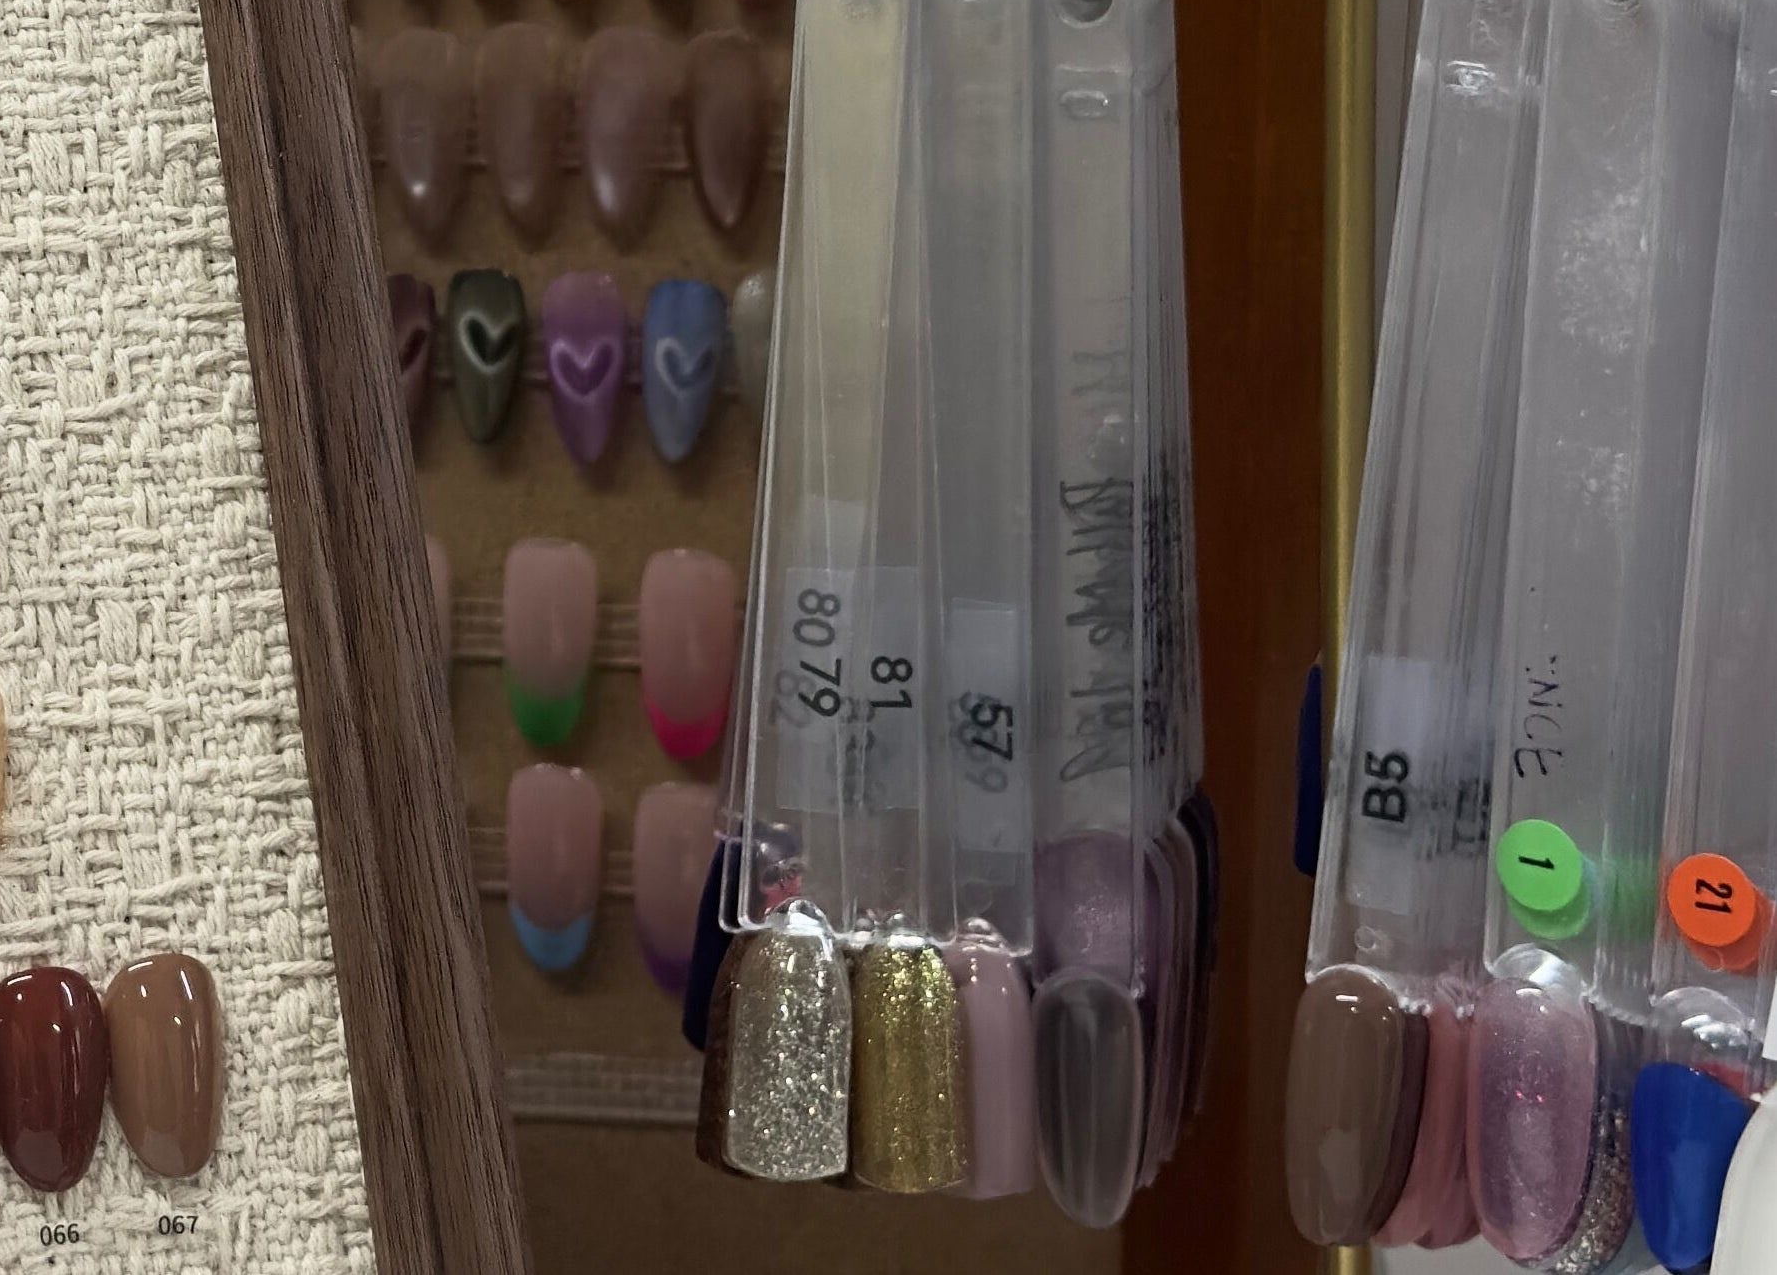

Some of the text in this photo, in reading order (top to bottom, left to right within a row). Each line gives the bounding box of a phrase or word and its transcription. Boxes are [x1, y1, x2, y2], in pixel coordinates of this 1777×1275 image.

[791, 587, 842, 648] 80
[797, 657, 843, 719] 79
[870, 655, 914, 711] 81
[970, 701, 1014, 763] 57
[1361, 750, 1410, 824] B5
[1517, 854, 1556, 872] 1
[1694, 876, 1734, 916] 21
[40, 1223, 80, 1247] 066
[157, 1215, 199, 1237] 067
